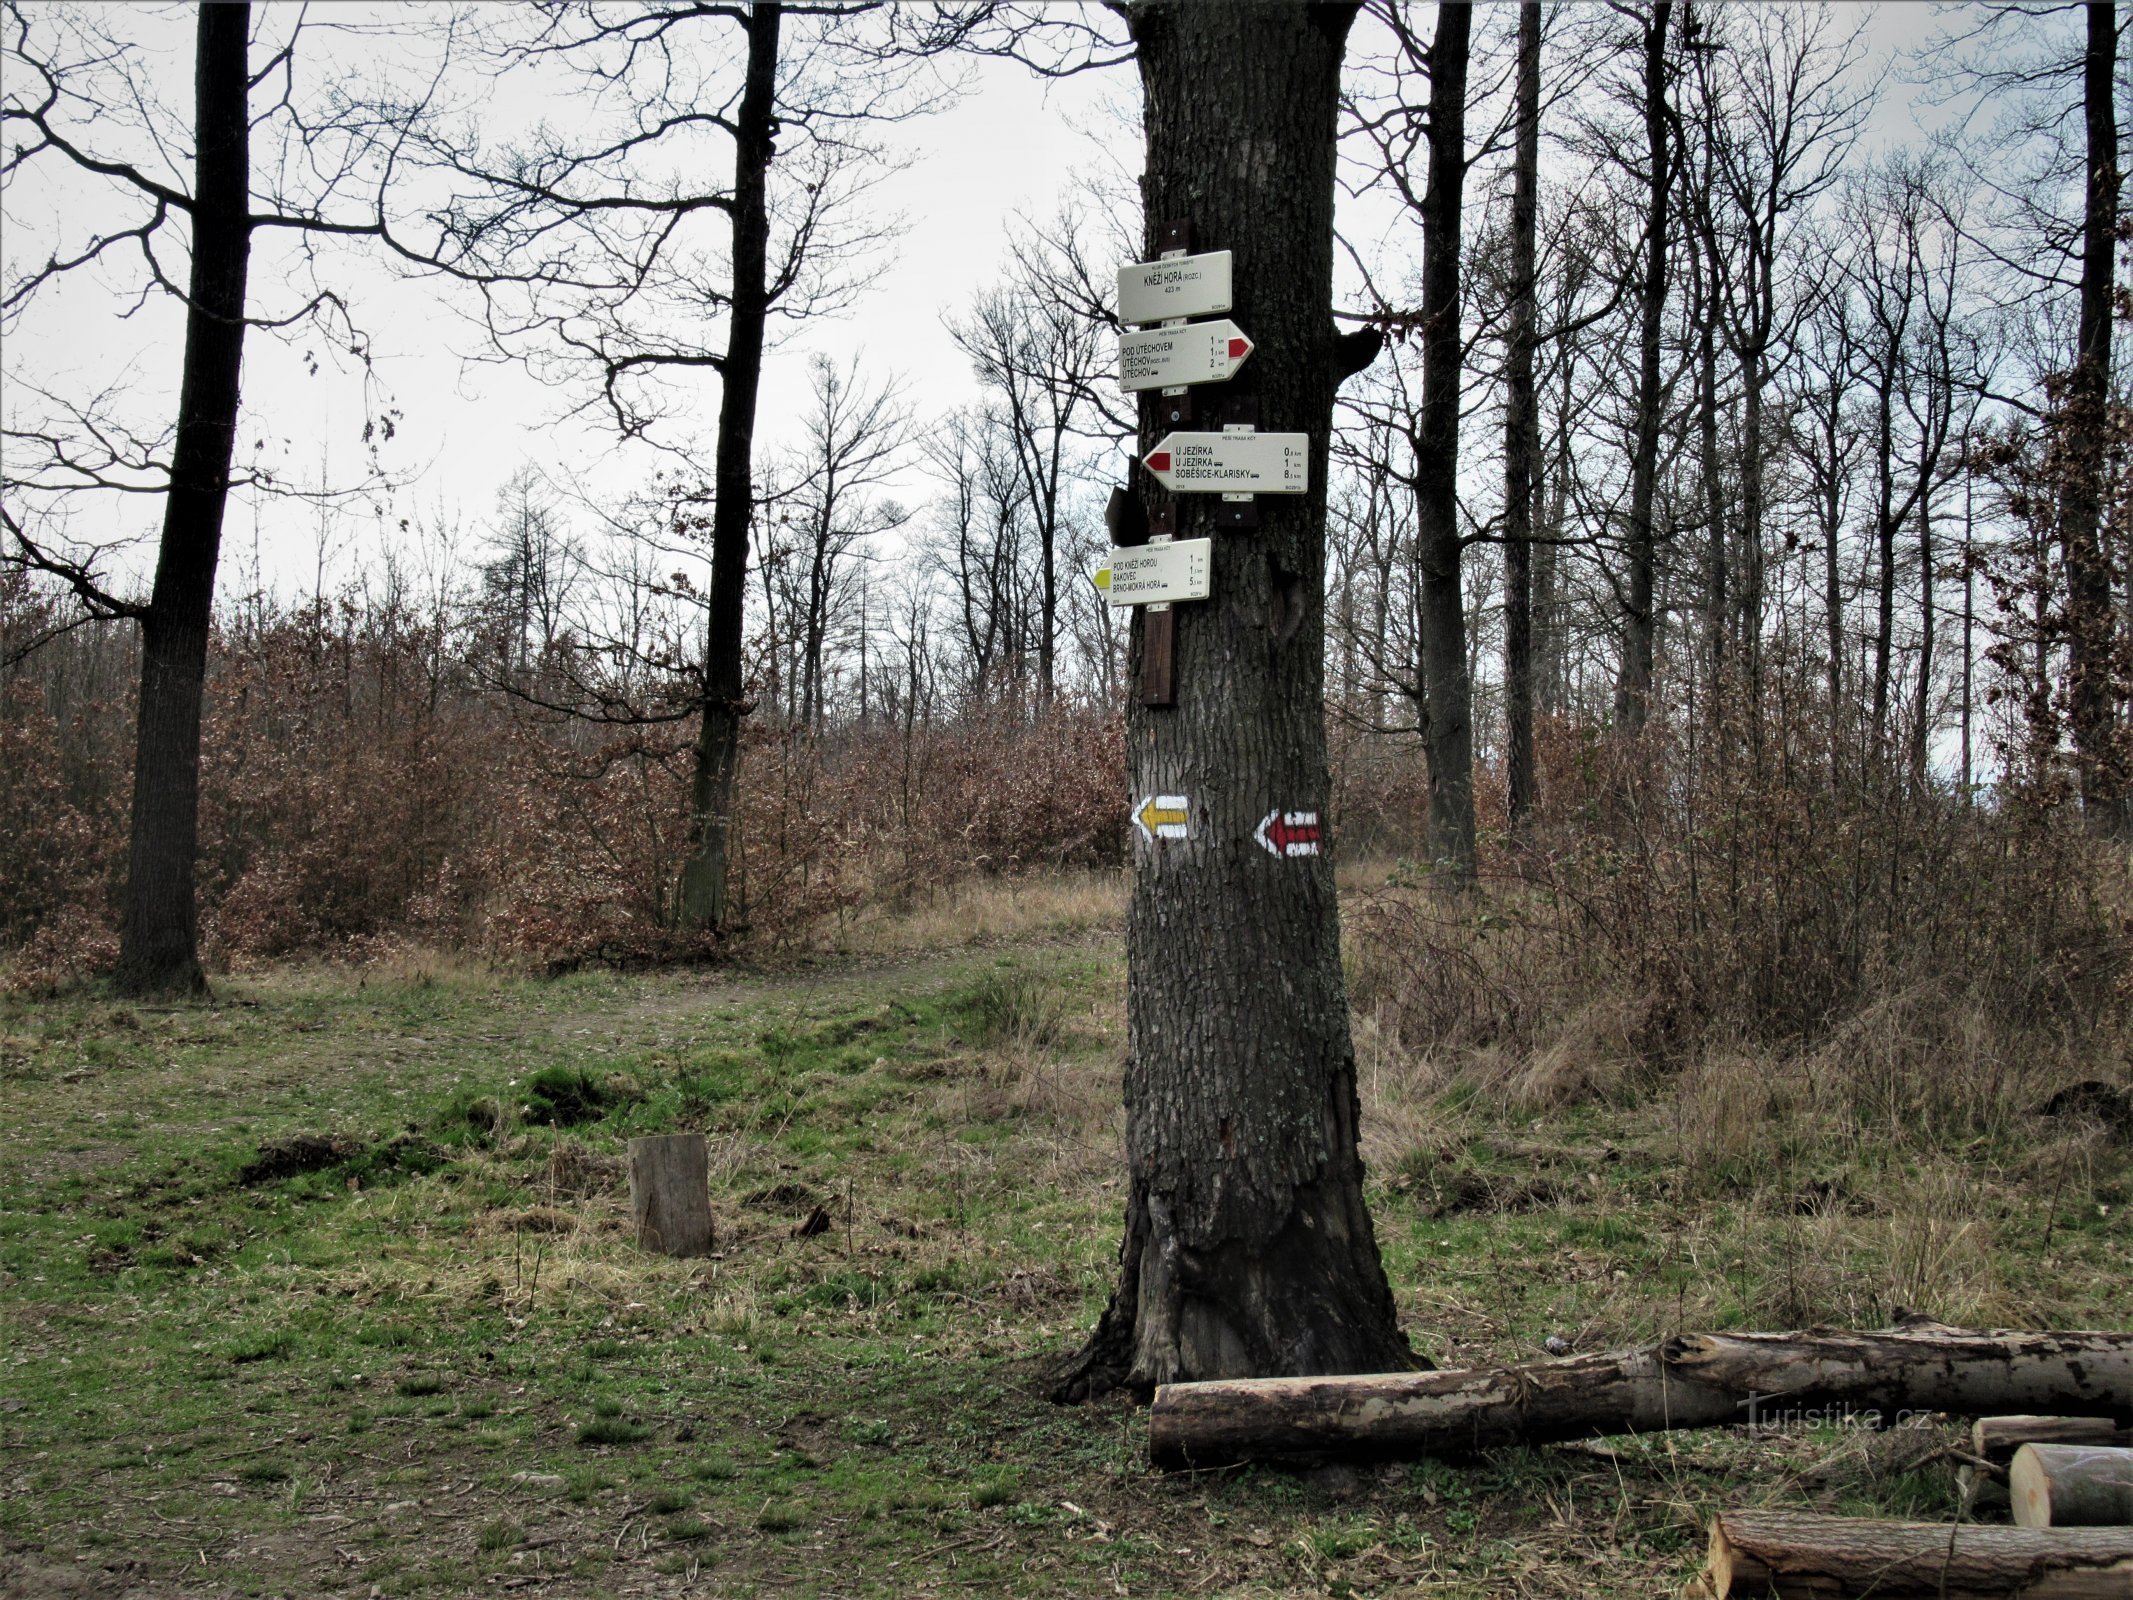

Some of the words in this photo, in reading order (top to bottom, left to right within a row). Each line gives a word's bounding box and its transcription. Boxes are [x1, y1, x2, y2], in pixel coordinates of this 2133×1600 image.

[1144, 272, 1162, 287] KNĚŽÍ
[1164, 271, 1182, 283] HORA
[1122, 347, 1134, 356] POD
[1136, 341, 1173, 354] ÚTĚCHOVEM
[1211, 336, 1214, 344] 1
[1122, 356, 1150, 368] ÚTĚCHOV
[1122, 367, 1150, 379] ÚTĚCHOV
[1210, 358, 1214, 368] 2
[1176, 446, 1181, 455] U
[1183, 444, 1213, 455] JEZÍRKA
[1176, 458, 1180, 466] U
[1183, 456, 1212, 466] JEZÍRKA
[1285, 458, 1288, 467] 1
[1175, 467, 1250, 478] SOBĚŠICE-KLARISKY
[1113, 562, 1123, 571] POD
[1125, 558, 1138, 570] KNĚŽÍ
[1140, 558, 1158, 568] HOROU
[1190, 554, 1193, 563] 1
[1113, 571, 1136, 582] RAKOVEC
[1113, 580, 1145, 593] BRNO-MOKRÁ
[1147, 580, 1160, 589] HORA
